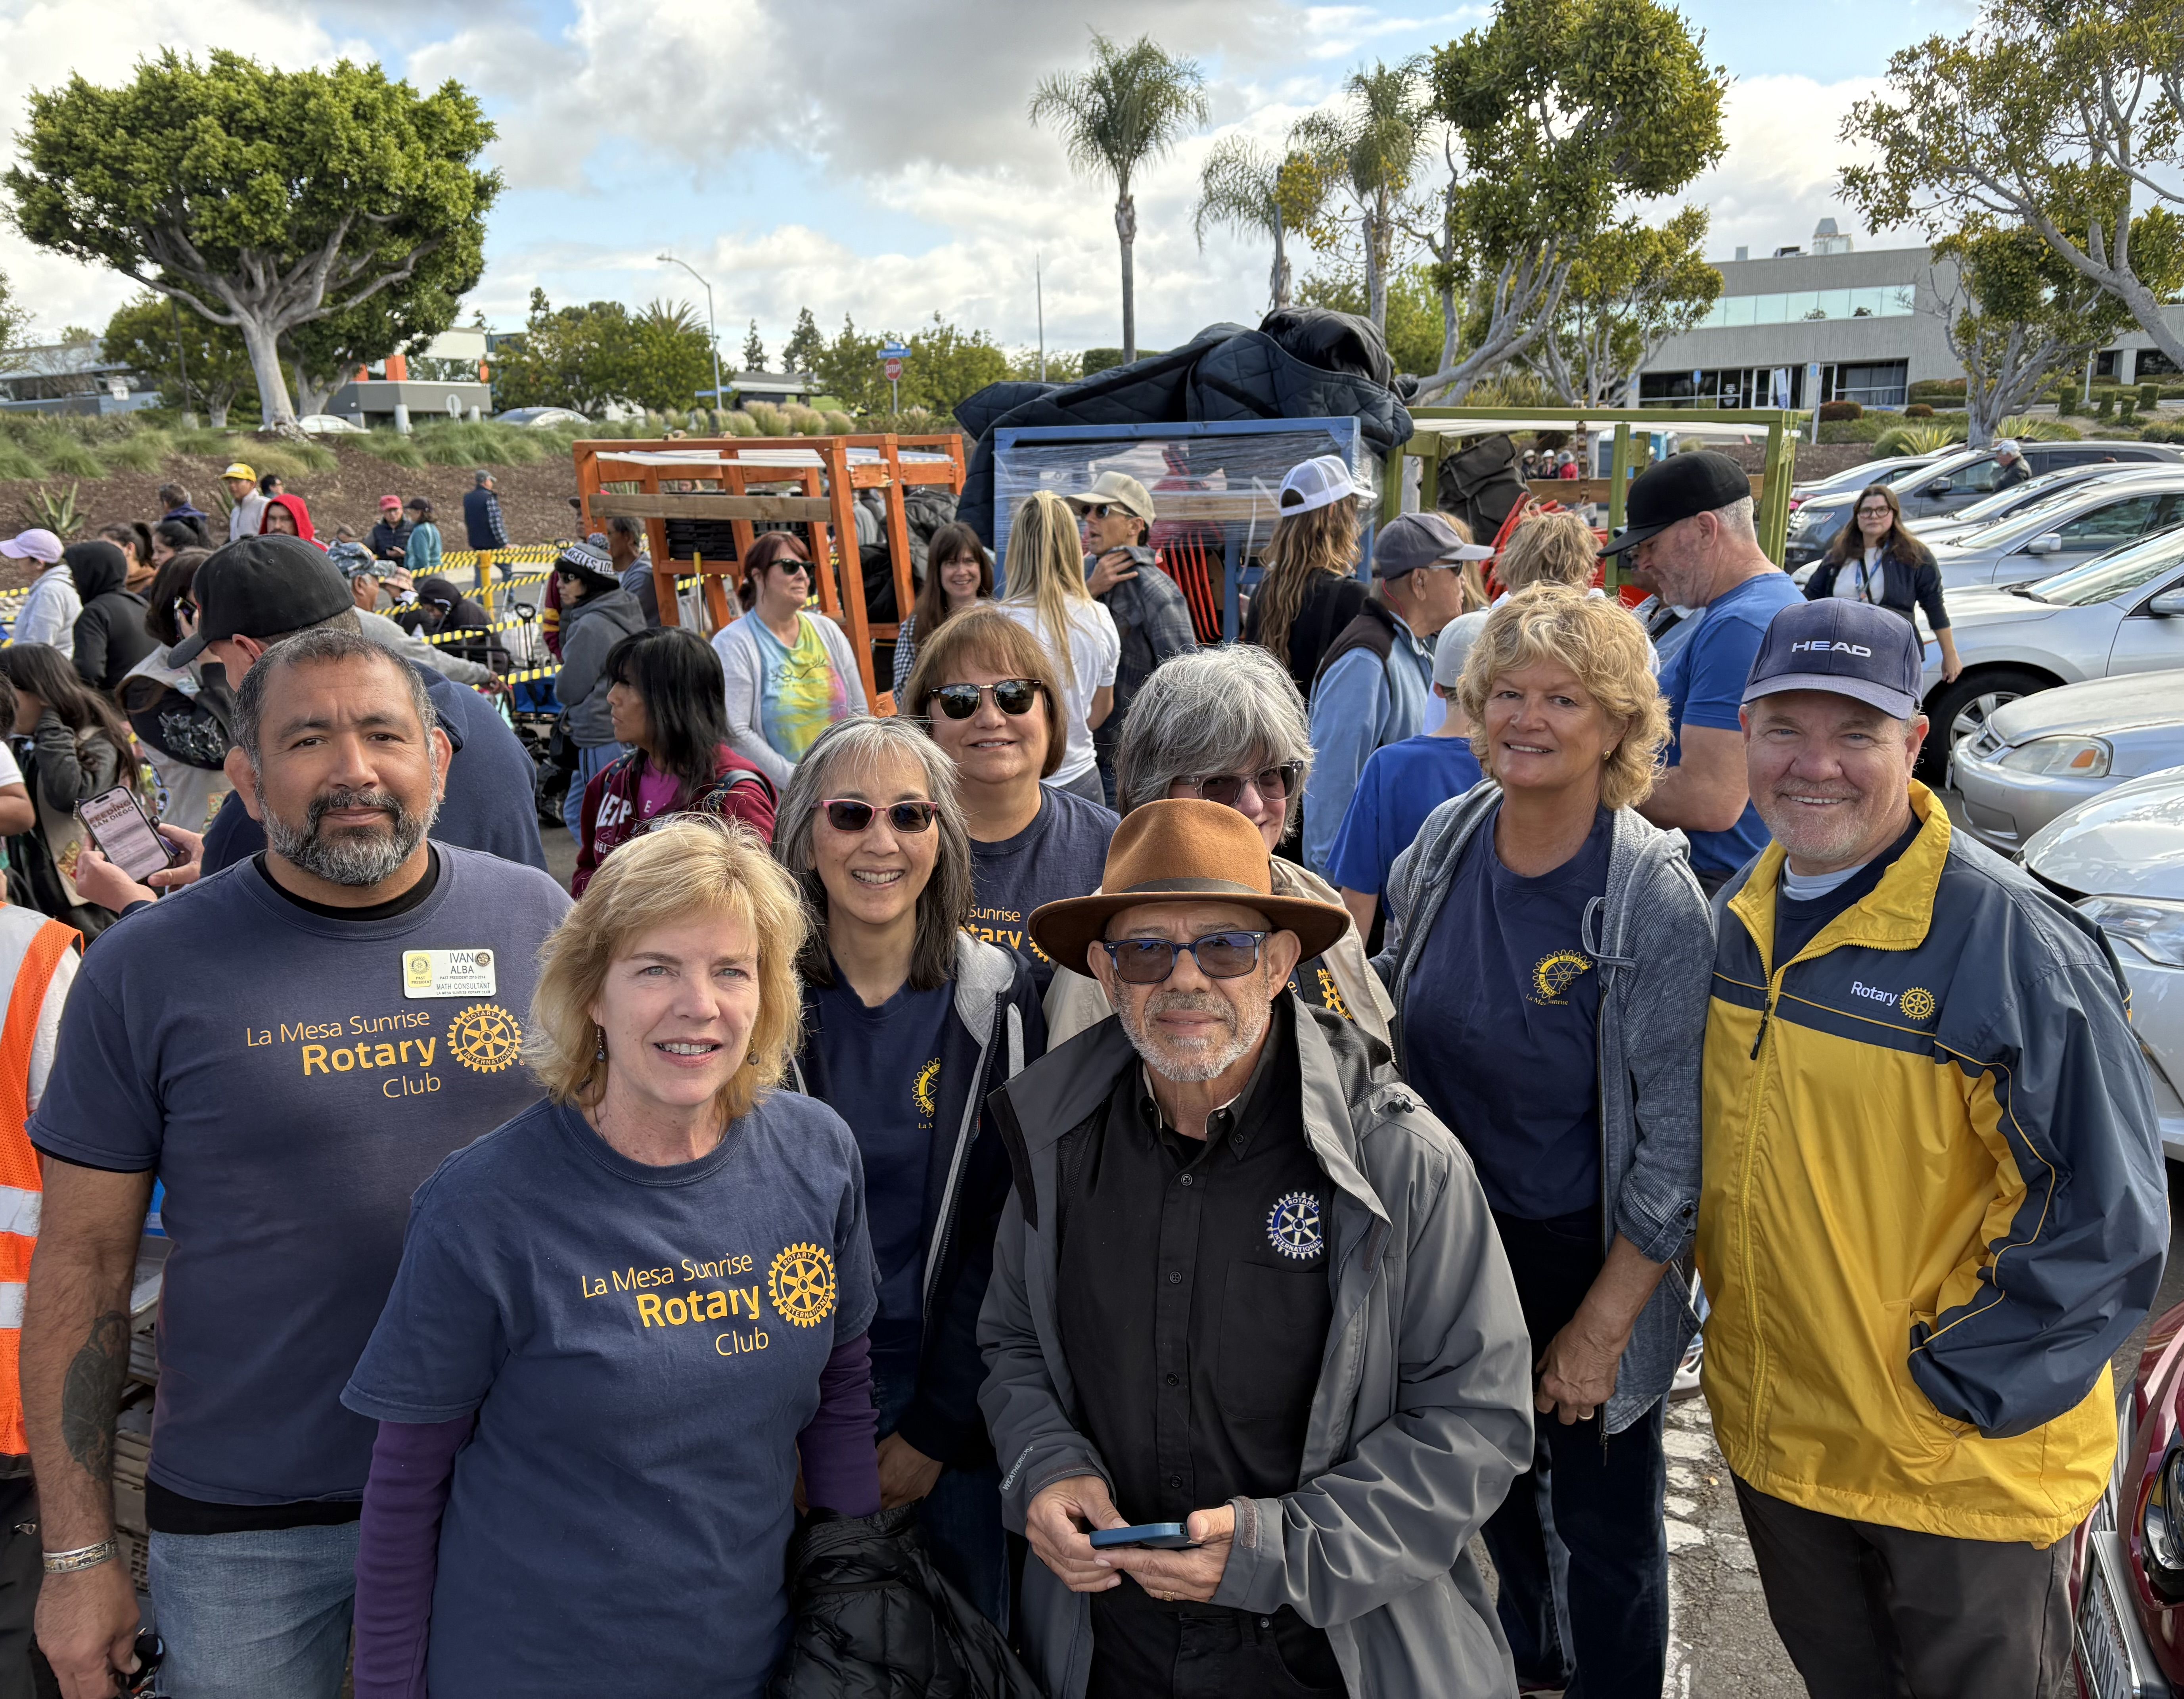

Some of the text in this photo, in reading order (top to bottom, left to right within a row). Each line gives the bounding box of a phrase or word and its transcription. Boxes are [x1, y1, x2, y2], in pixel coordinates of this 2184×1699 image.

[1792, 641, 1872, 658] HEAD
[88, 800, 131, 824] FEEDING
[92, 806, 134, 830] SAN DIEGO
[450, 953, 474, 963] IVAN
[450, 965, 474, 974] ALBA
[1563, 956, 1586, 968] ROTARY
[1851, 981, 1898, 1006] Rotary
[247, 1010, 430, 1047] La Mesa Sunrise
[466, 1011, 495, 1022] ROTARY
[302, 1037, 436, 1076] Rotary
[464, 1044, 515, 1065] INTERNATIONAL
[383, 1072, 441, 1098] Club
[1288, 1198, 1317, 1208] ROTARY
[1273, 1233, 1321, 1252] INTERNATIONAL
[782, 1252, 812, 1266] ROTARY
[582, 1252, 753, 1298] La Mesa Sunrise
[636, 1285, 760, 1327] Rotary
[784, 1292, 830, 1318] INTERNATIONAL
[715, 1327, 769, 1356] Club
[2086, 1588, 2126, 1699] 8KWN1
